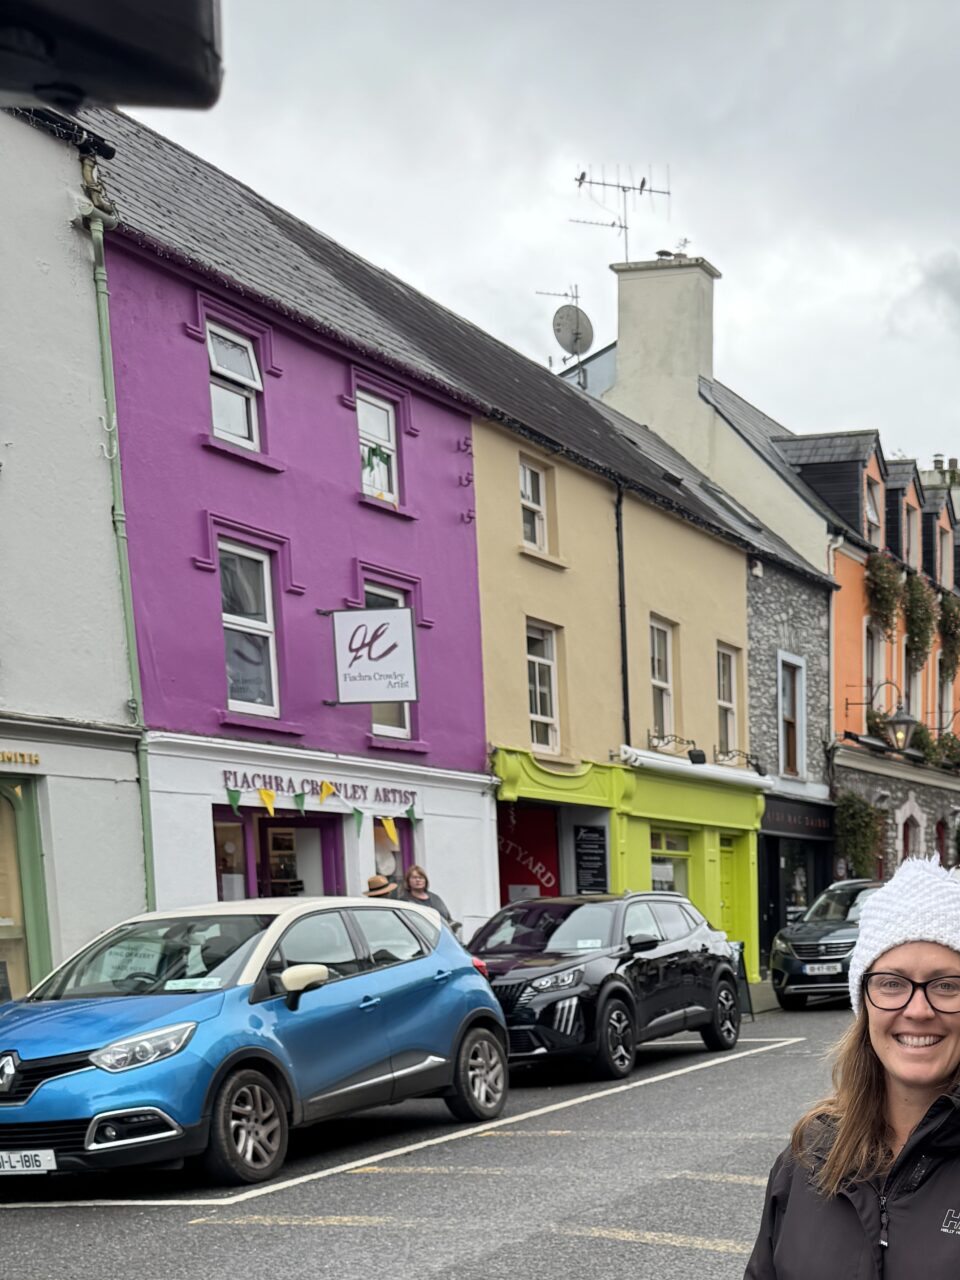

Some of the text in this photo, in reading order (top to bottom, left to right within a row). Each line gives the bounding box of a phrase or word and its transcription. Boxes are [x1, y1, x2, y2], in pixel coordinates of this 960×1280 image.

[343, 671, 405, 682] Fiachra Crowley
[386, 681, 409, 689] Artist
[223, 770, 297, 794] FIACHRA
[374, 786, 417, 806] ARTIST
